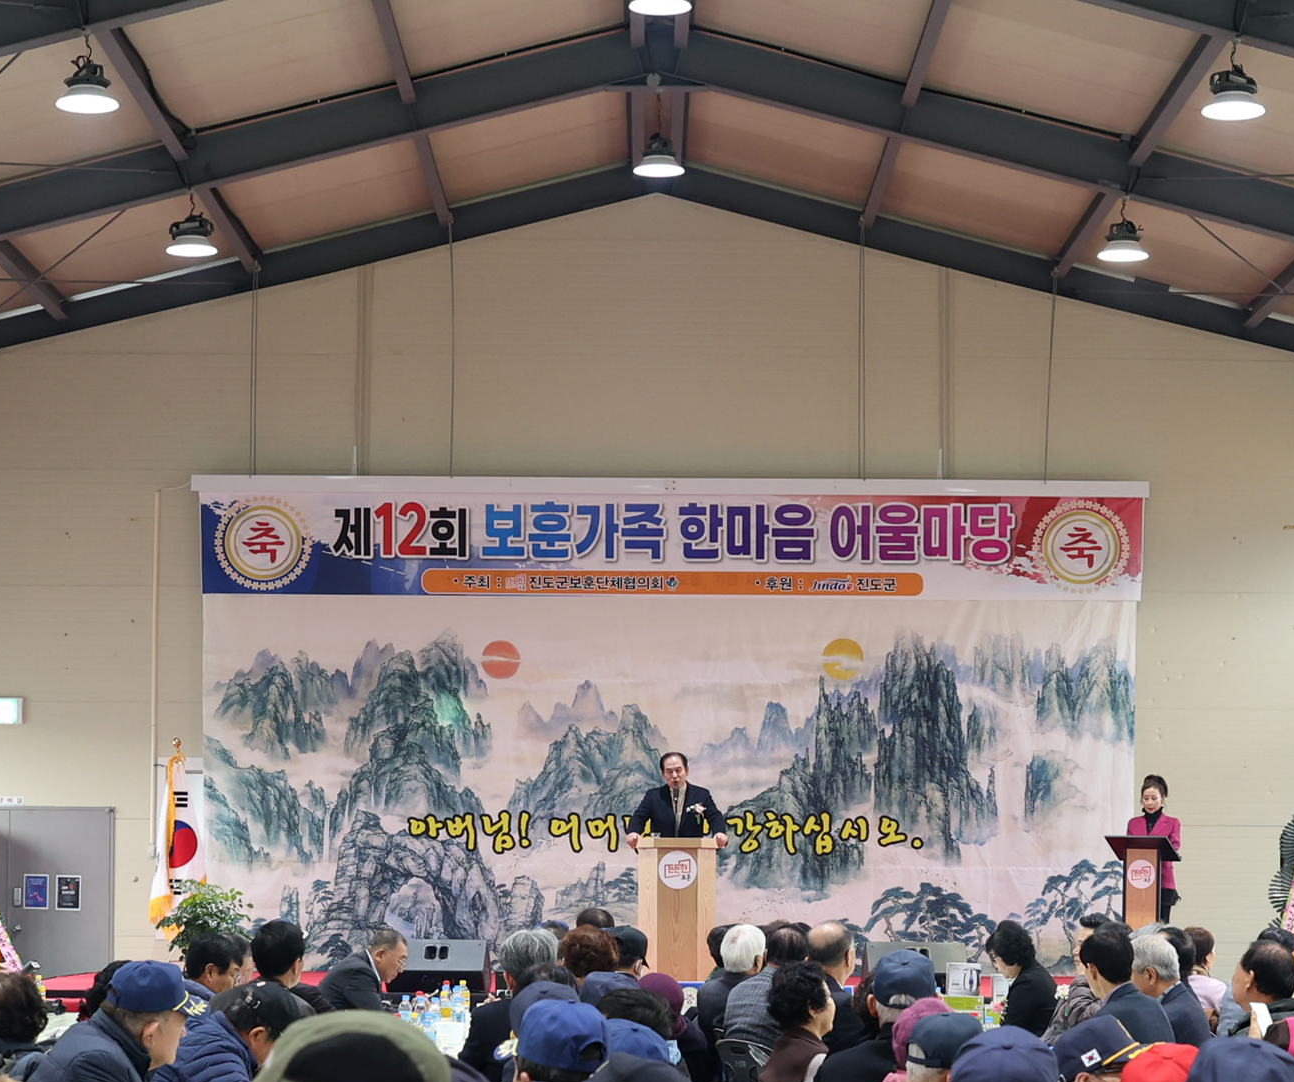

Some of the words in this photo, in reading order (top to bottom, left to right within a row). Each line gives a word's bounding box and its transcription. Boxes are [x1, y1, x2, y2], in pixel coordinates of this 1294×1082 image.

[242, 521, 285, 564] 축
[332, 501, 468, 558] 제12회
[481, 501, 667, 561] 보훈가족
[678, 501, 815, 562] 한마음
[830, 502, 1014, 563] 어울마당
[1059, 526, 1103, 569] 축
[462, 575, 491, 589] 주최
[528, 575, 664, 590] 진도군보훈단체협의회
[765, 576, 793, 591] 후원
[856, 577, 897, 592] 진도군
[407, 810, 532, 854] 아버님!
